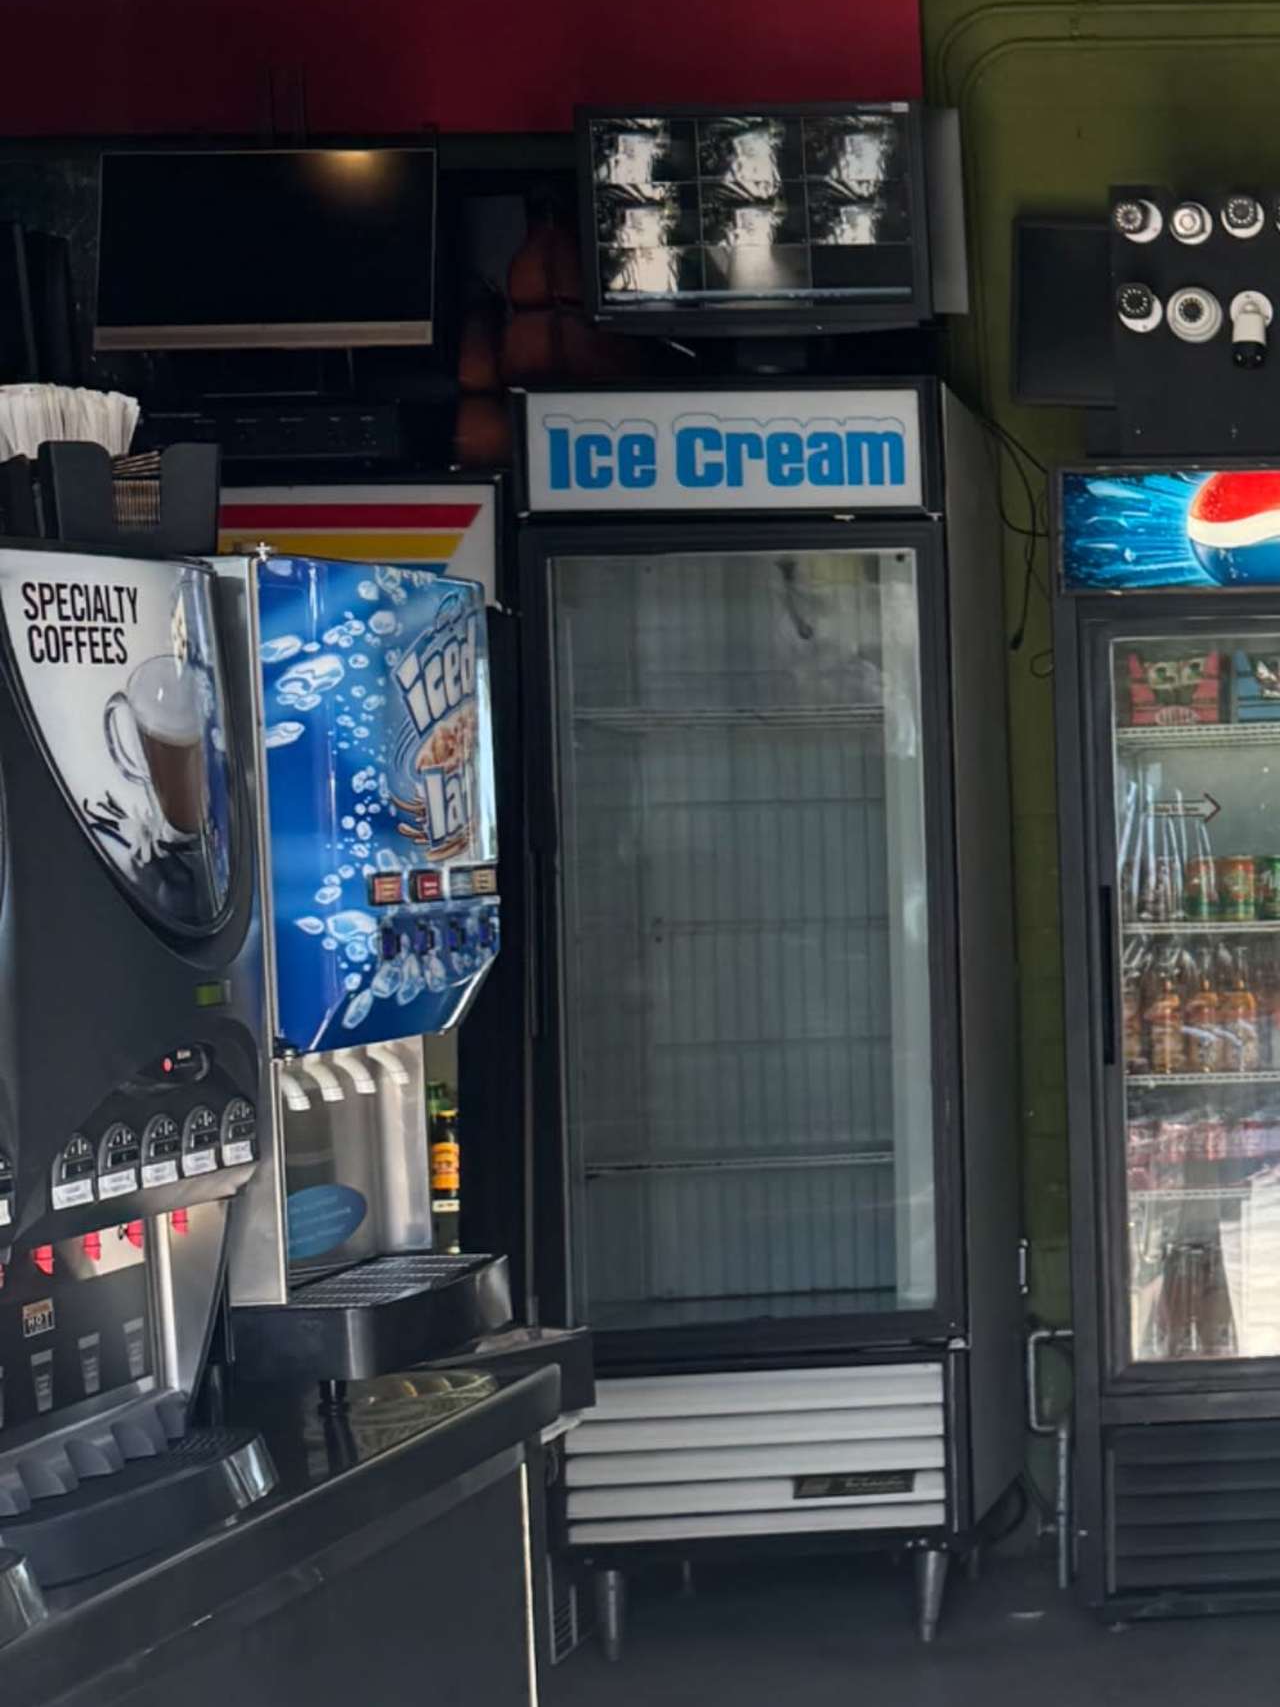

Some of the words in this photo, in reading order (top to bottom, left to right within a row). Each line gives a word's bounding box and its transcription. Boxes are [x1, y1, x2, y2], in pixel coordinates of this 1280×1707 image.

[549, 427, 657, 491] Ice
[675, 426, 906, 488] Cream
[22, 582, 138, 625] SPECIALTY
[27, 625, 128, 665] COFFEES
